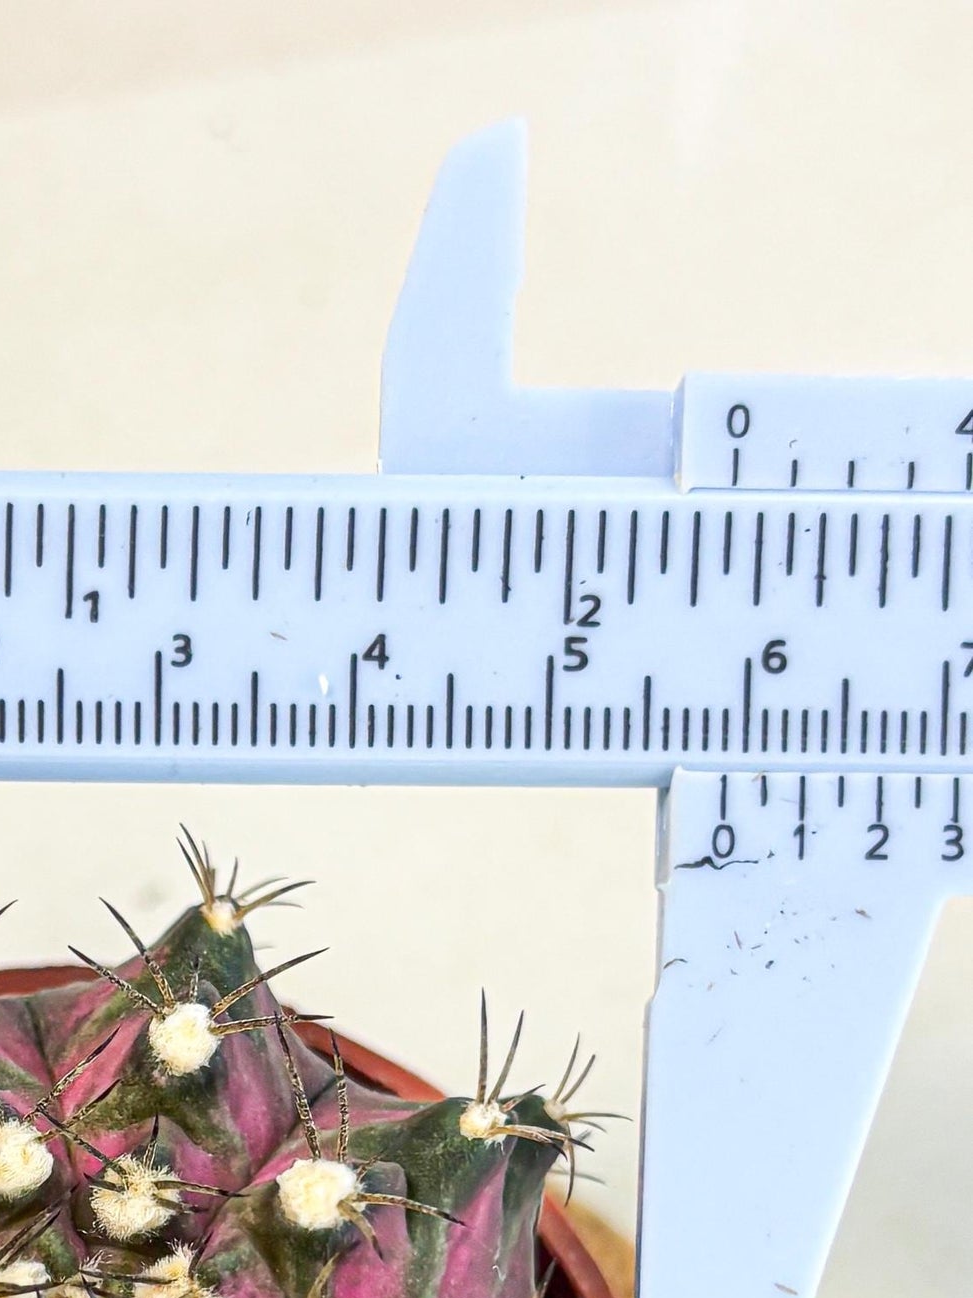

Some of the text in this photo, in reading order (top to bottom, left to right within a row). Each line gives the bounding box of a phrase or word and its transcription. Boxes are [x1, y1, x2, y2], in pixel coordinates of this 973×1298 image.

[726, 404, 750, 438] 0
[83, 590, 100, 623] 1
[576, 594, 602, 628] 2
[170, 633, 193, 668] 3
[362, 633, 390, 670] 4
[562, 636, 589, 672] 5
[761, 639, 788, 675] 6
[711, 823, 965, 861] 0 1 2 3
